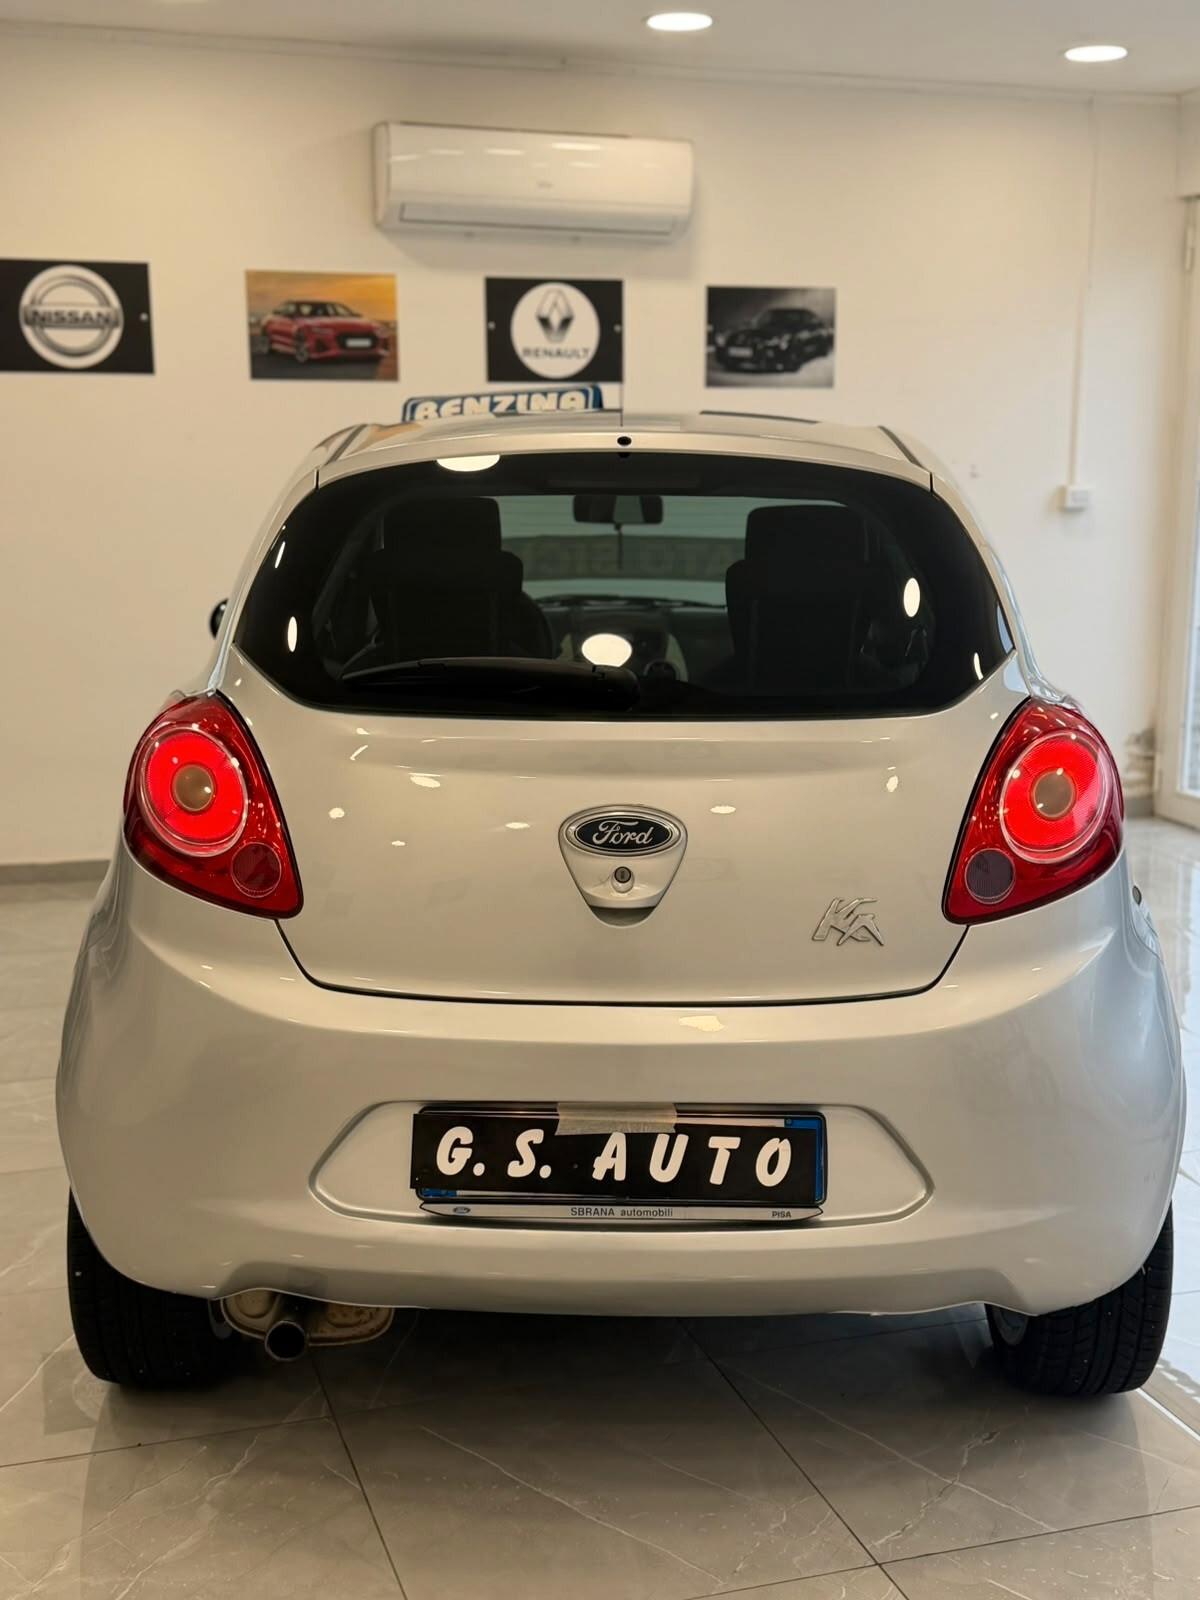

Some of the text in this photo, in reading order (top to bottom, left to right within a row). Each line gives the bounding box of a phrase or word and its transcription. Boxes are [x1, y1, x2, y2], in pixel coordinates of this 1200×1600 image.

[31, 309, 111, 325] NISSAN
[522, 346, 591, 360] RENAULT
[413, 389, 586, 422] BENZINA
[592, 819, 654, 846] Ford
[435, 1125, 792, 1188] G. S. AUTO
[570, 1206, 792, 1219] SBRANA automobili PISA
